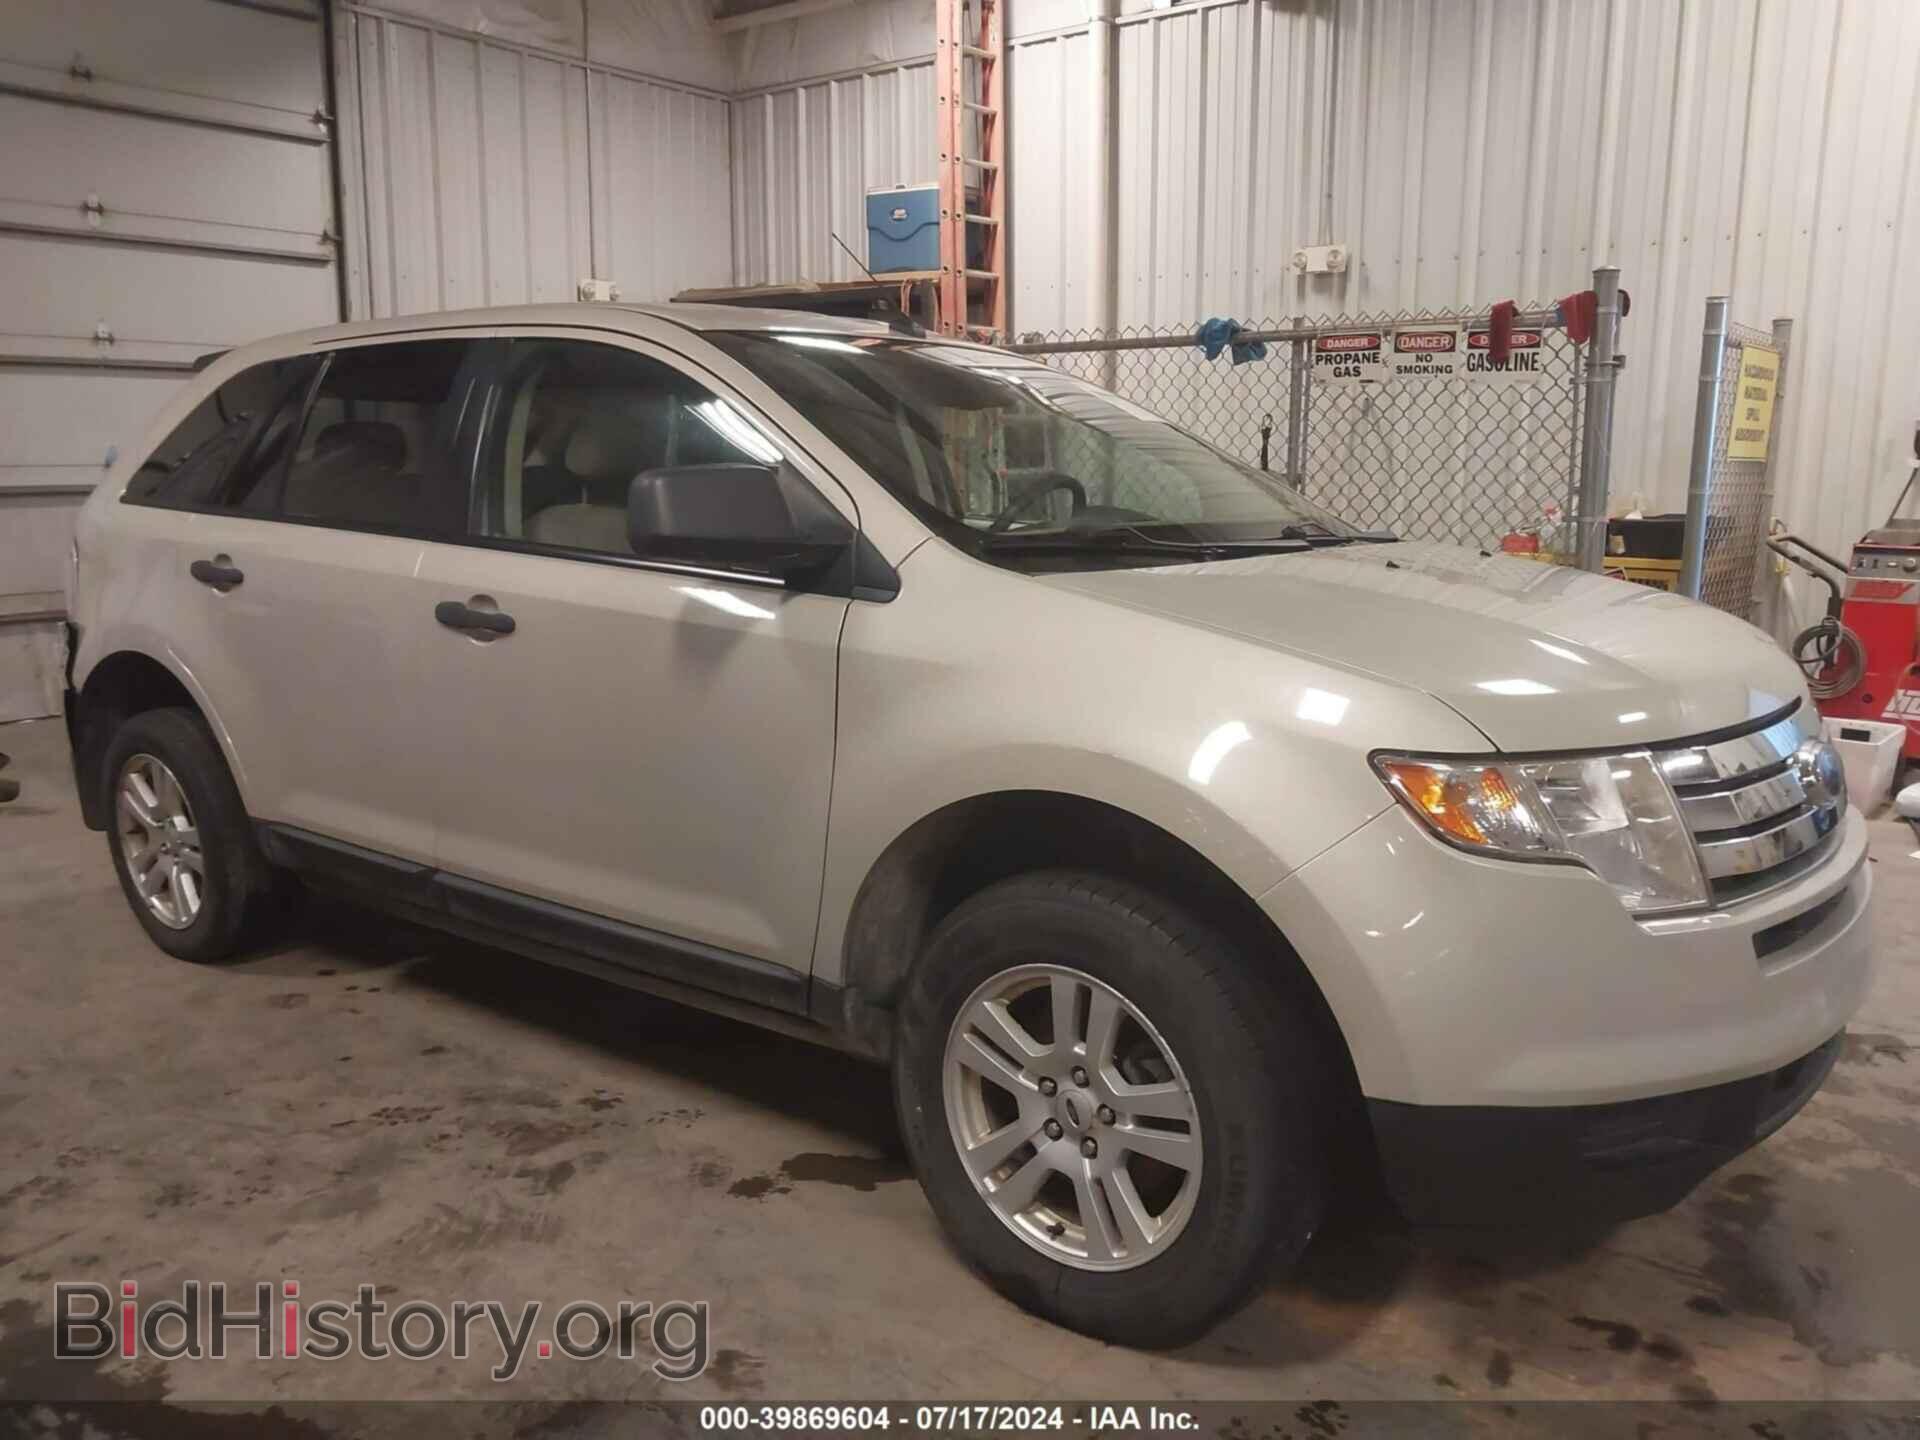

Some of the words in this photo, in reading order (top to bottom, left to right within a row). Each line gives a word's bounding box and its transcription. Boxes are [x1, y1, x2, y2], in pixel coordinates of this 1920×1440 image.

[1327, 337, 1368, 349] DANGER
[1400, 336, 1450, 349] DANGER
[1480, 335, 1528, 345] DER
[1315, 352, 1380, 366] PROPANE
[1415, 353, 1433, 363] NO
[1333, 366, 1361, 378] GAS
[1396, 364, 1453, 374] SMOKING
